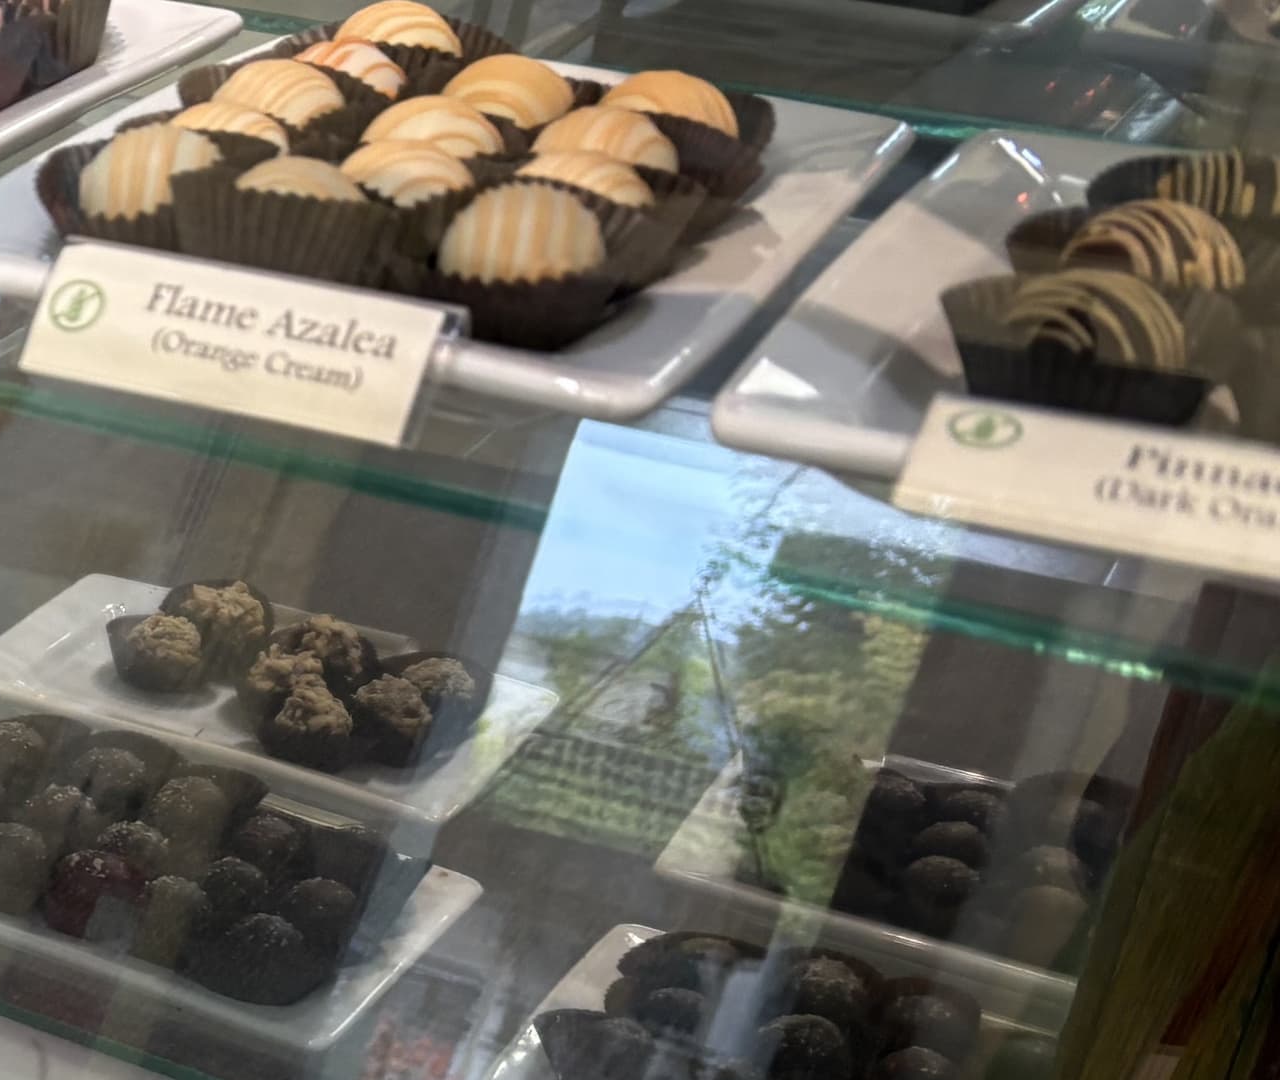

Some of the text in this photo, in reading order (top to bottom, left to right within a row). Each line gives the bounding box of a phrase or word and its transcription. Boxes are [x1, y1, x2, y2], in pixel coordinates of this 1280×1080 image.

[144, 281, 399, 361] Flame Azalea
[150, 326, 365, 392] (Orange Cream)
[1094, 475, 1193, 514] (Dark
[1126, 444, 1280, 494] Pinna
